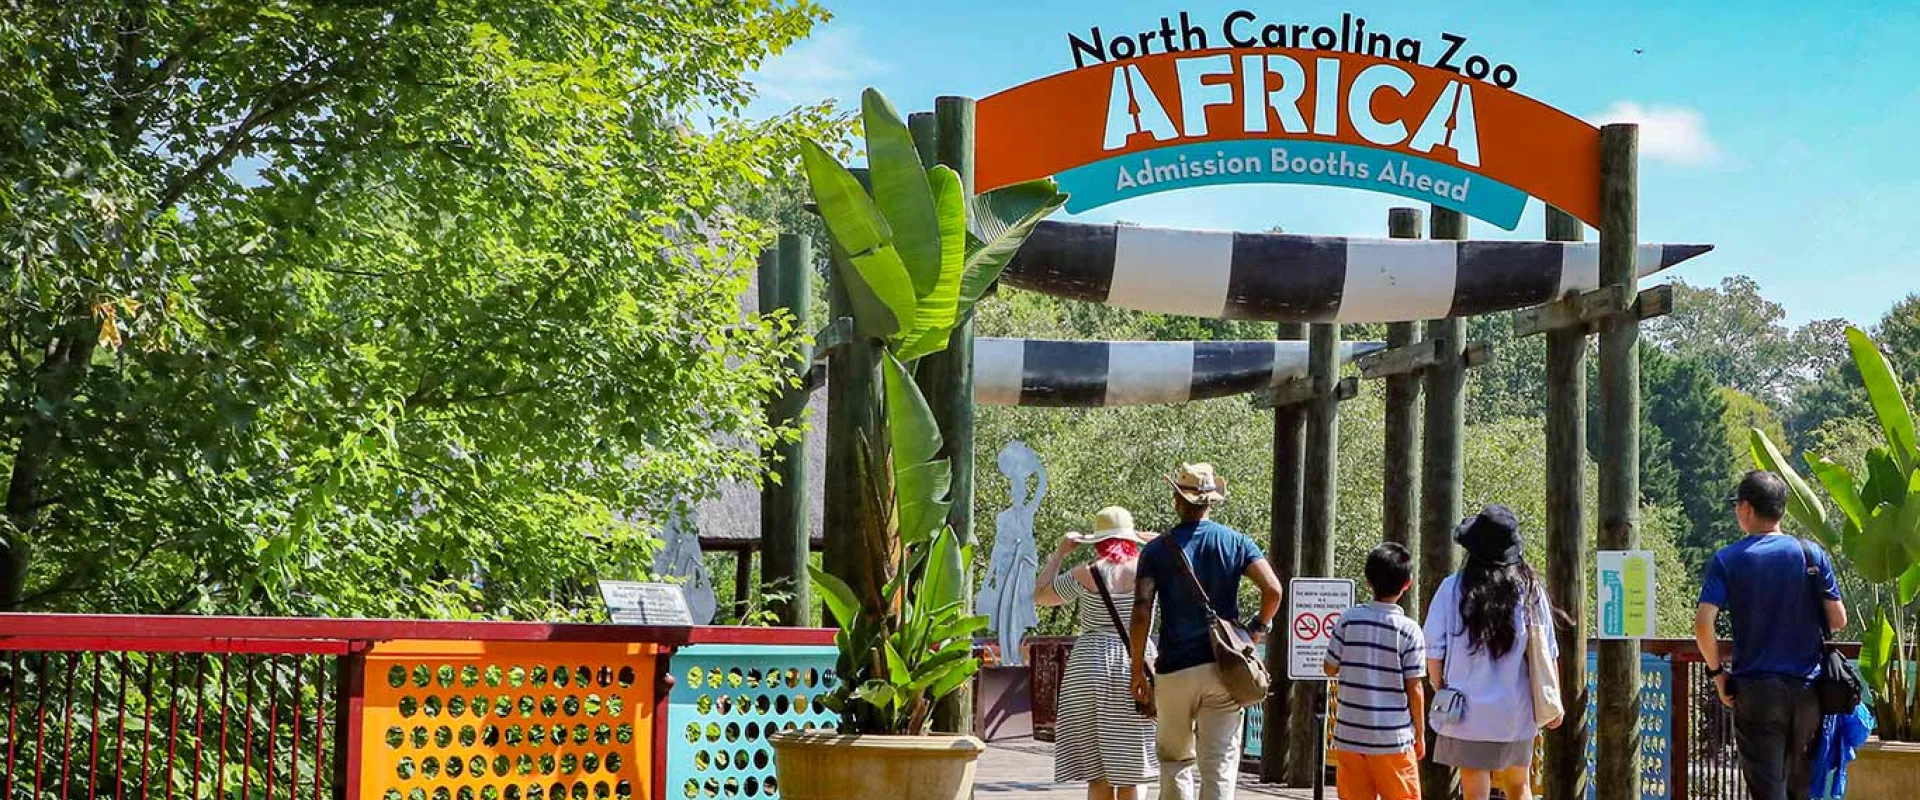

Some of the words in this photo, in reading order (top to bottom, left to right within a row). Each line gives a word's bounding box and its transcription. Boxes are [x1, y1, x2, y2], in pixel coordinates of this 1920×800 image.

[1068, 12, 1207, 69] North
[1223, 10, 1421, 65] Carolina
[1434, 33, 1518, 89] Zoo
[1102, 53, 1481, 167] AFRICA
[1115, 149, 1260, 193] Admission
[1270, 147, 1370, 179] Booths
[1377, 160, 1470, 203] Ahead
